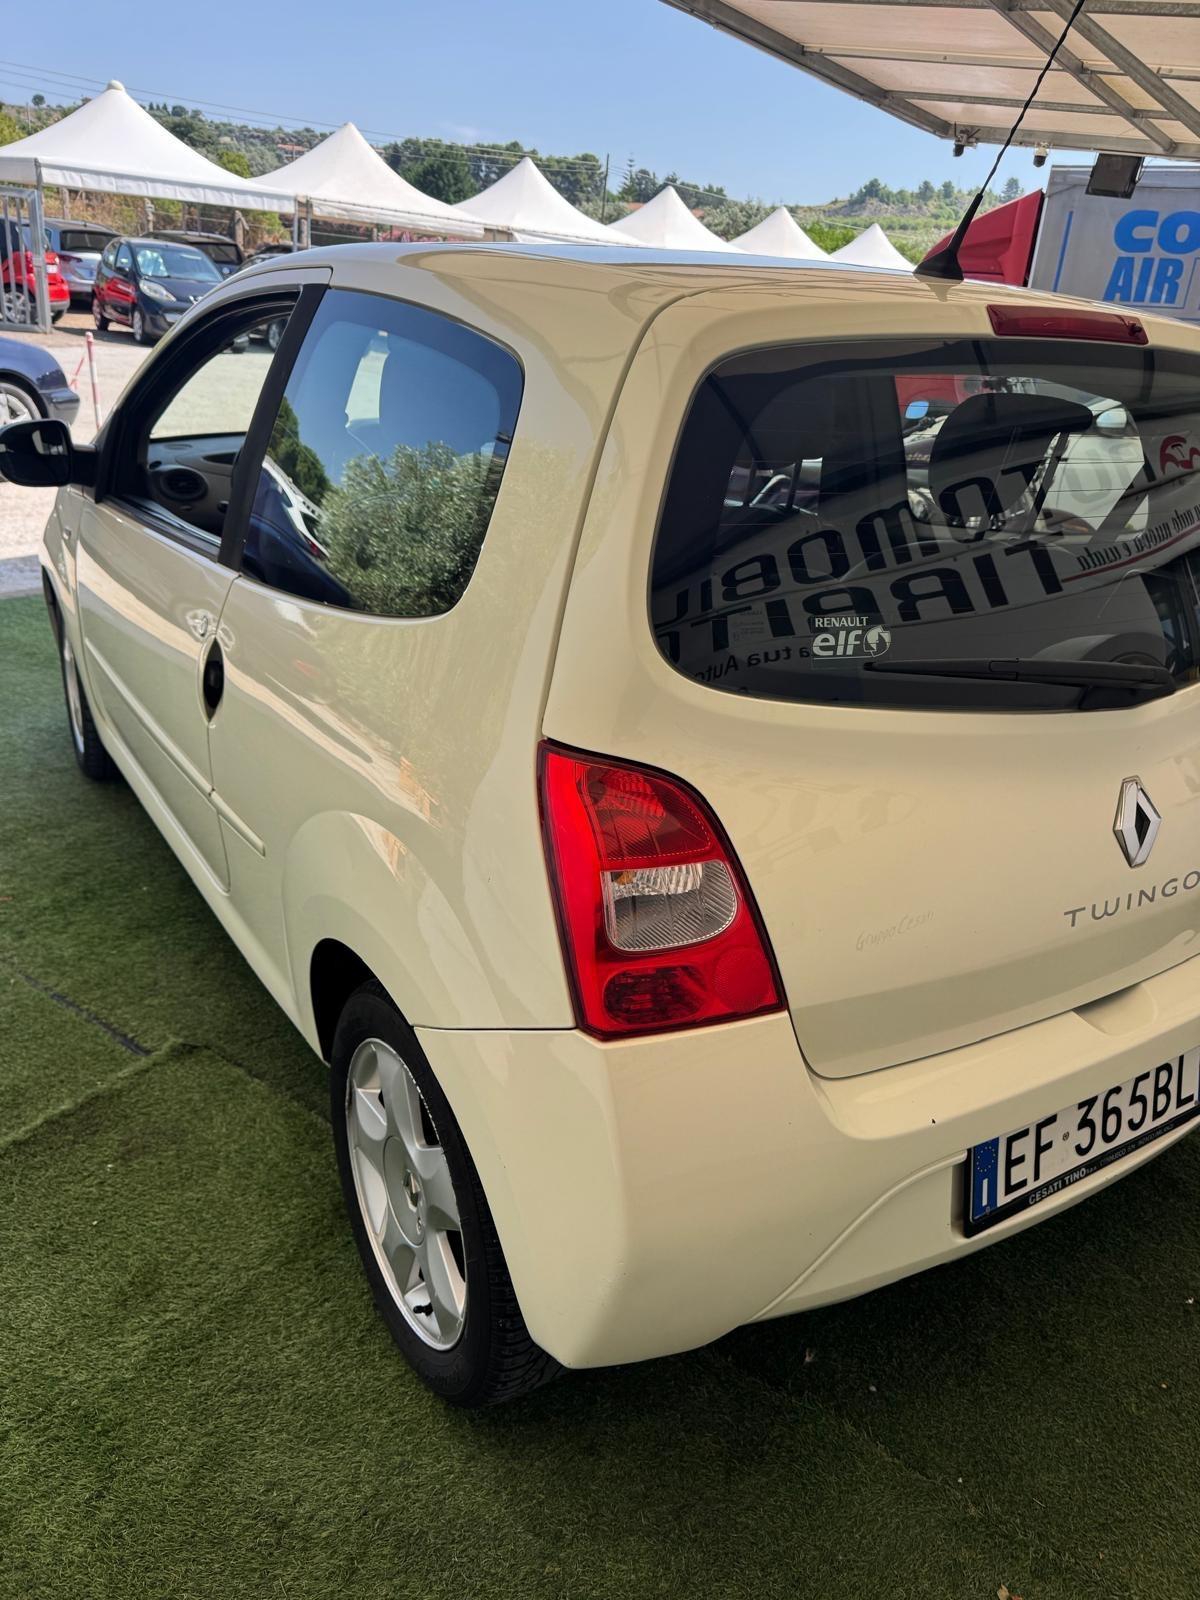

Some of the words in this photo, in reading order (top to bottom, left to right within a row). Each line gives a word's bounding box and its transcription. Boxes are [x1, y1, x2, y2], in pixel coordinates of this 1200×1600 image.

[1103, 256, 1184, 304] AIR
[812, 630, 863, 656] elf
[815, 616, 869, 628] RENAULT
[1063, 870, 1200, 928] TWINGO
[1004, 1112, 1058, 1197] EF
[1075, 1054, 1195, 1157] 365BL
[1028, 1180, 1063, 1205] CESATI
[1063, 1167, 1087, 1186] TINO
